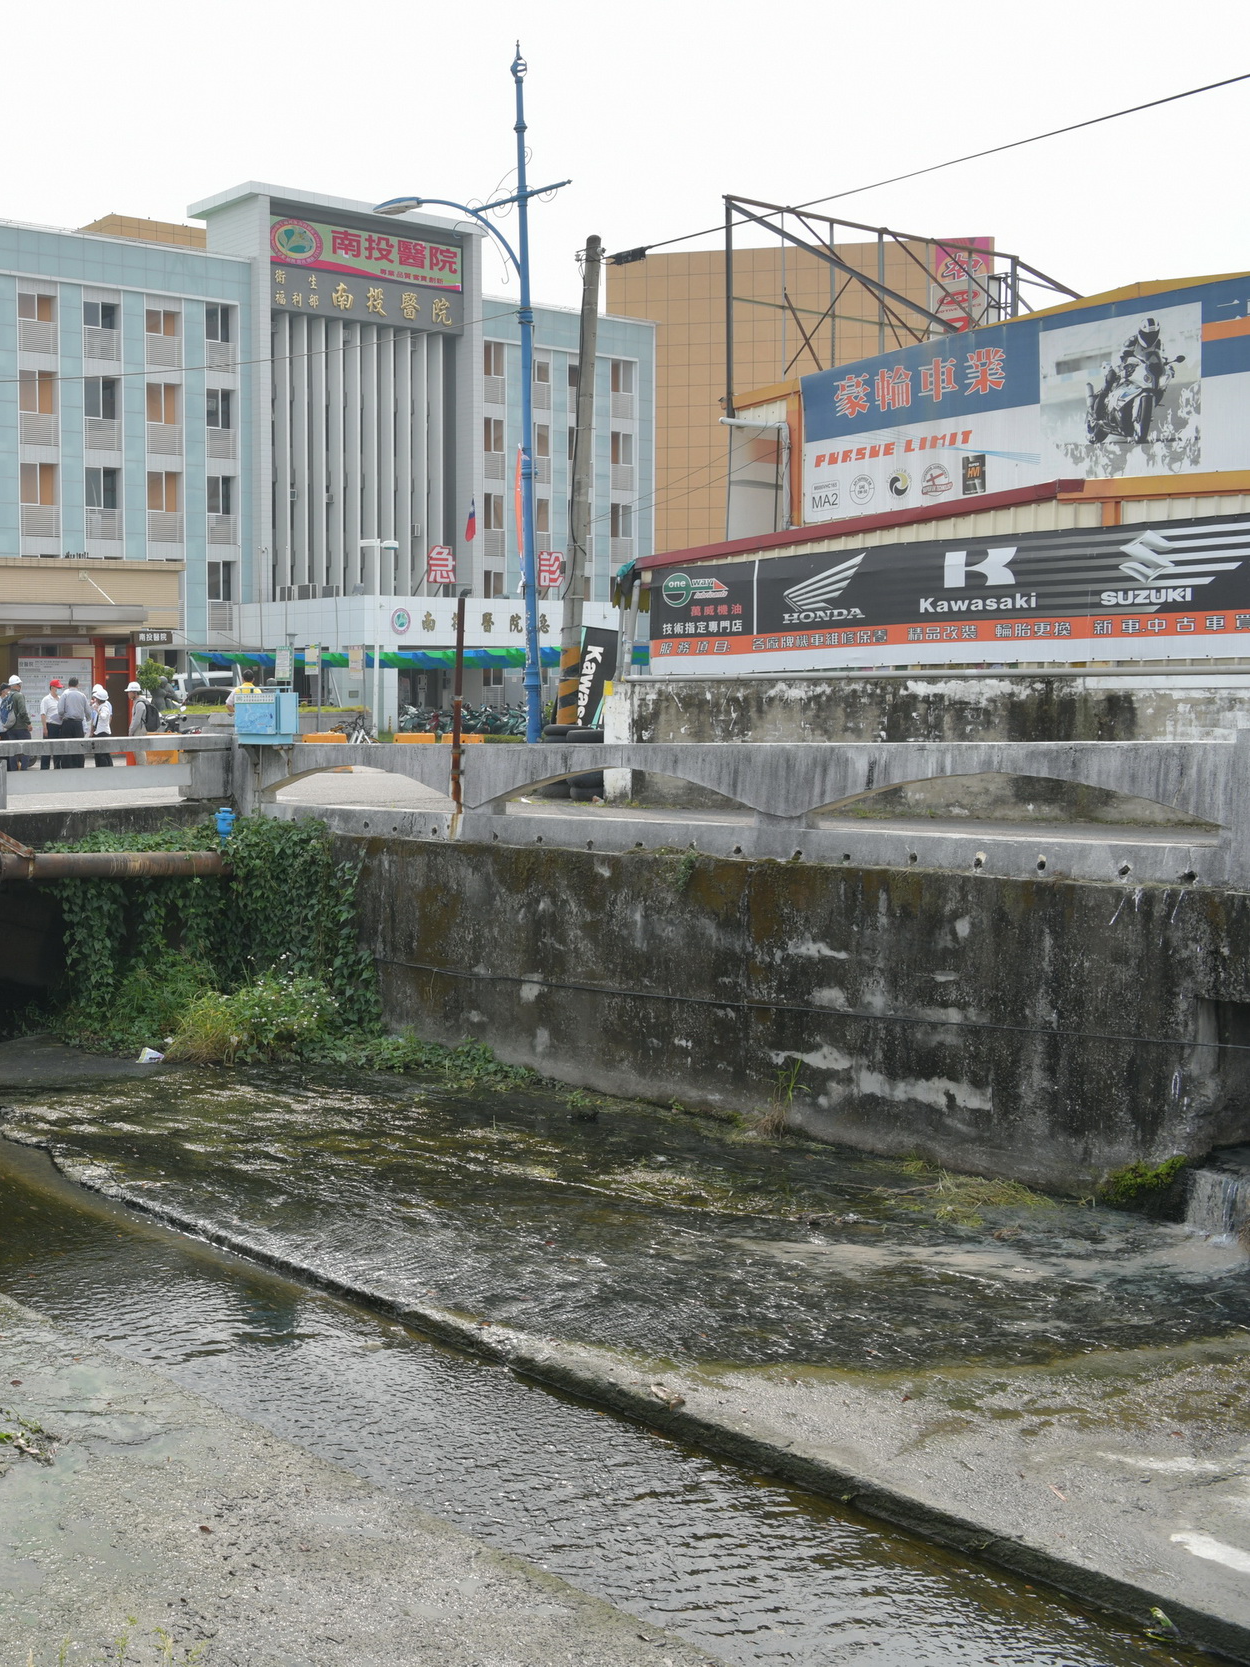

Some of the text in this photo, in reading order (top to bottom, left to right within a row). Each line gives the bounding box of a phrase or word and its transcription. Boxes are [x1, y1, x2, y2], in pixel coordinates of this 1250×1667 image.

[331, 229, 458, 275] 南投醫院
[332, 282, 452, 327] 南投醫院
[833, 347, 1006, 418] 豪輪車業
[814, 430, 973, 468] PURSUE LIMIT
[812, 492, 838, 509] MA2
[428, 545, 566, 587] 急 診
[668, 580, 686, 588] one
[919, 592, 1037, 613] Kawasaki
[1100, 587, 1192, 605] SUZUKI
[690, 603, 743, 617] 萬威機油
[782, 607, 866, 624] HONDA
[138, 632, 168, 642] 南投醫院
[662, 620, 743, 635] 技術指定專門店
[752, 628, 887, 651] 各廠牌機車維修保養
[907, 625, 978, 641] 精品改裝
[995, 621, 1071, 638] 輪胎更換
